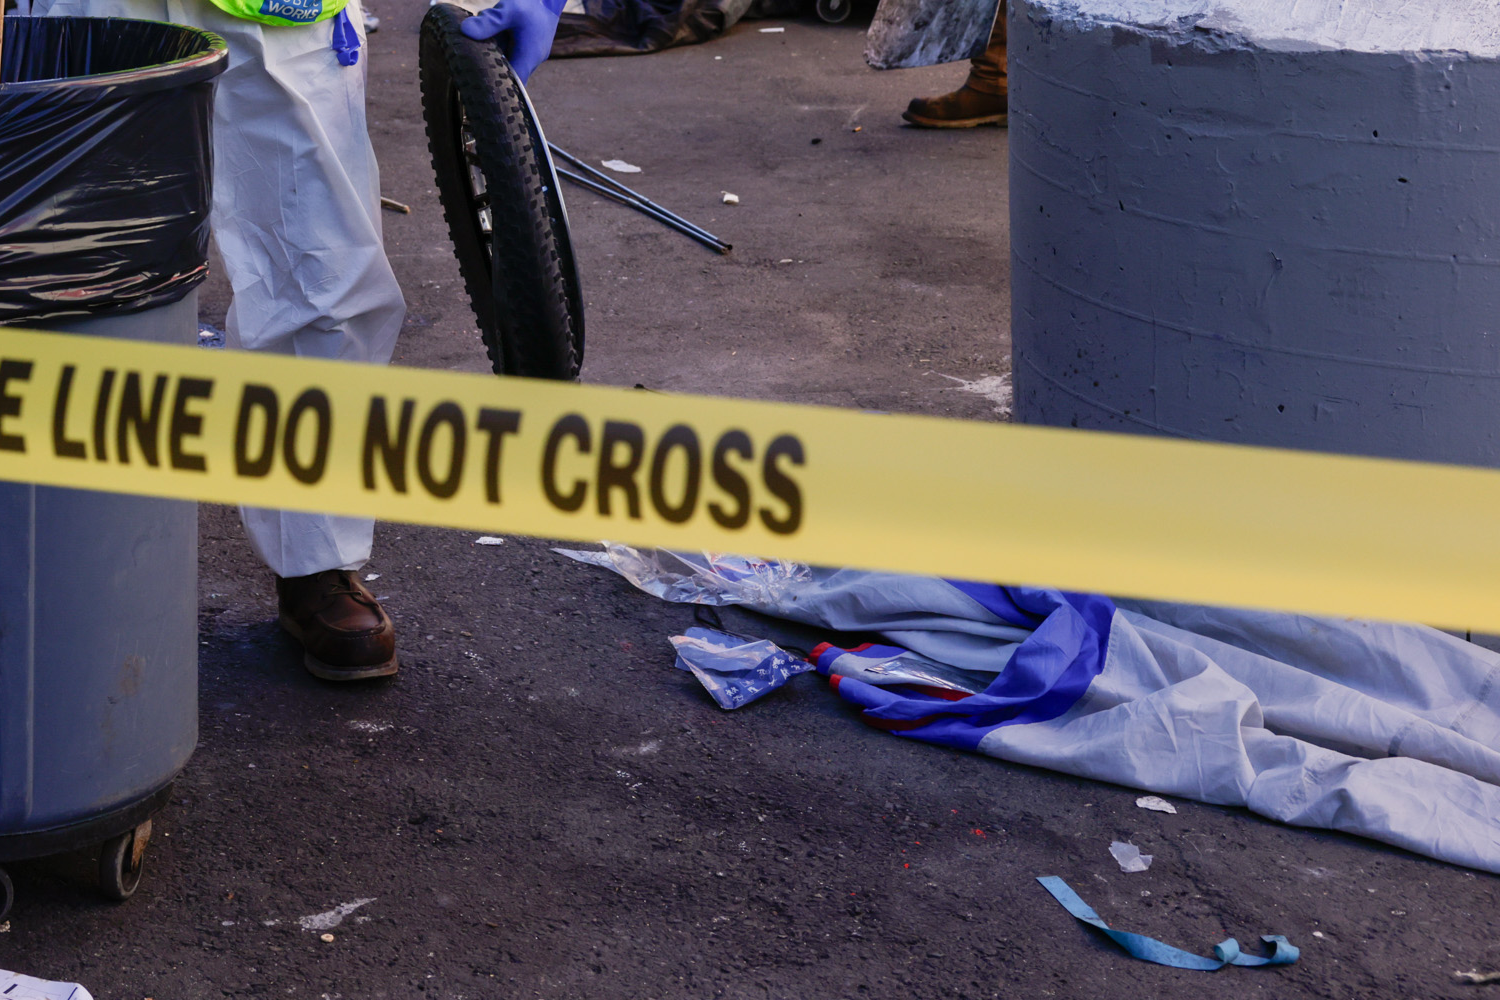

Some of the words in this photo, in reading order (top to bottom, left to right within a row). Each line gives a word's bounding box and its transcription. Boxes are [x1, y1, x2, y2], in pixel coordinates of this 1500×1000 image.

[53, 366, 215, 473] LINE
[234, 382, 332, 486] DO
[362, 396, 522, 504] NOT
[541, 413, 806, 535] CROSS
